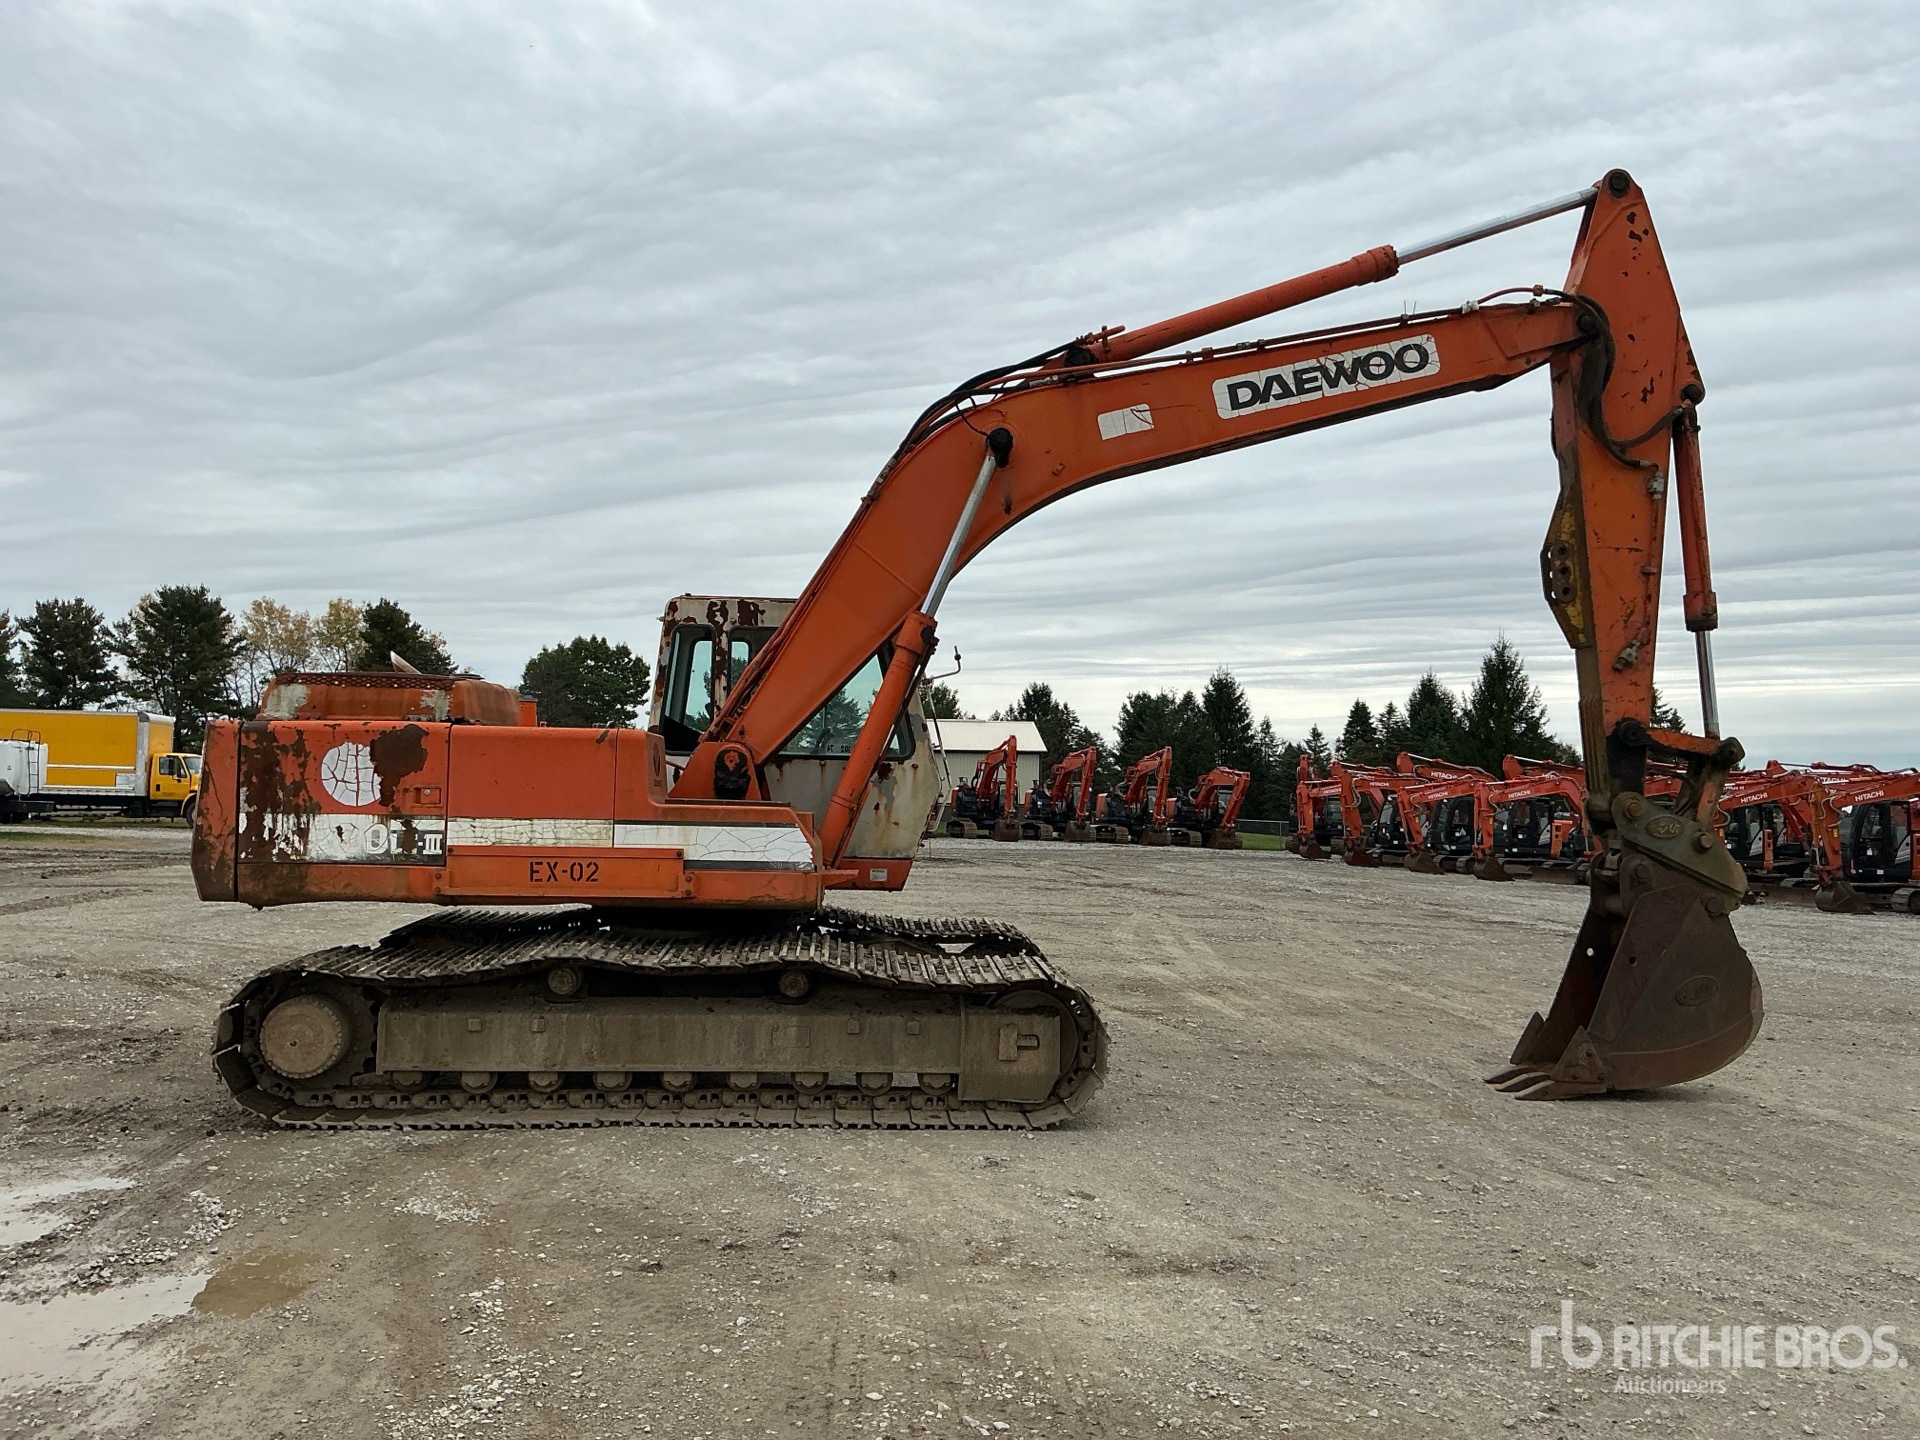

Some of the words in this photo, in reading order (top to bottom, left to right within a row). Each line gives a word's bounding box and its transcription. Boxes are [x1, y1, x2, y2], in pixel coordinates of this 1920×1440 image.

[1227, 343, 1430, 411] DAEWOO
[1508, 789, 1531, 799] HITACHI
[1740, 792, 1768, 804] HITACHI
[1855, 790, 1885, 802] HITACHI
[529, 861, 600, 882] EX-02
